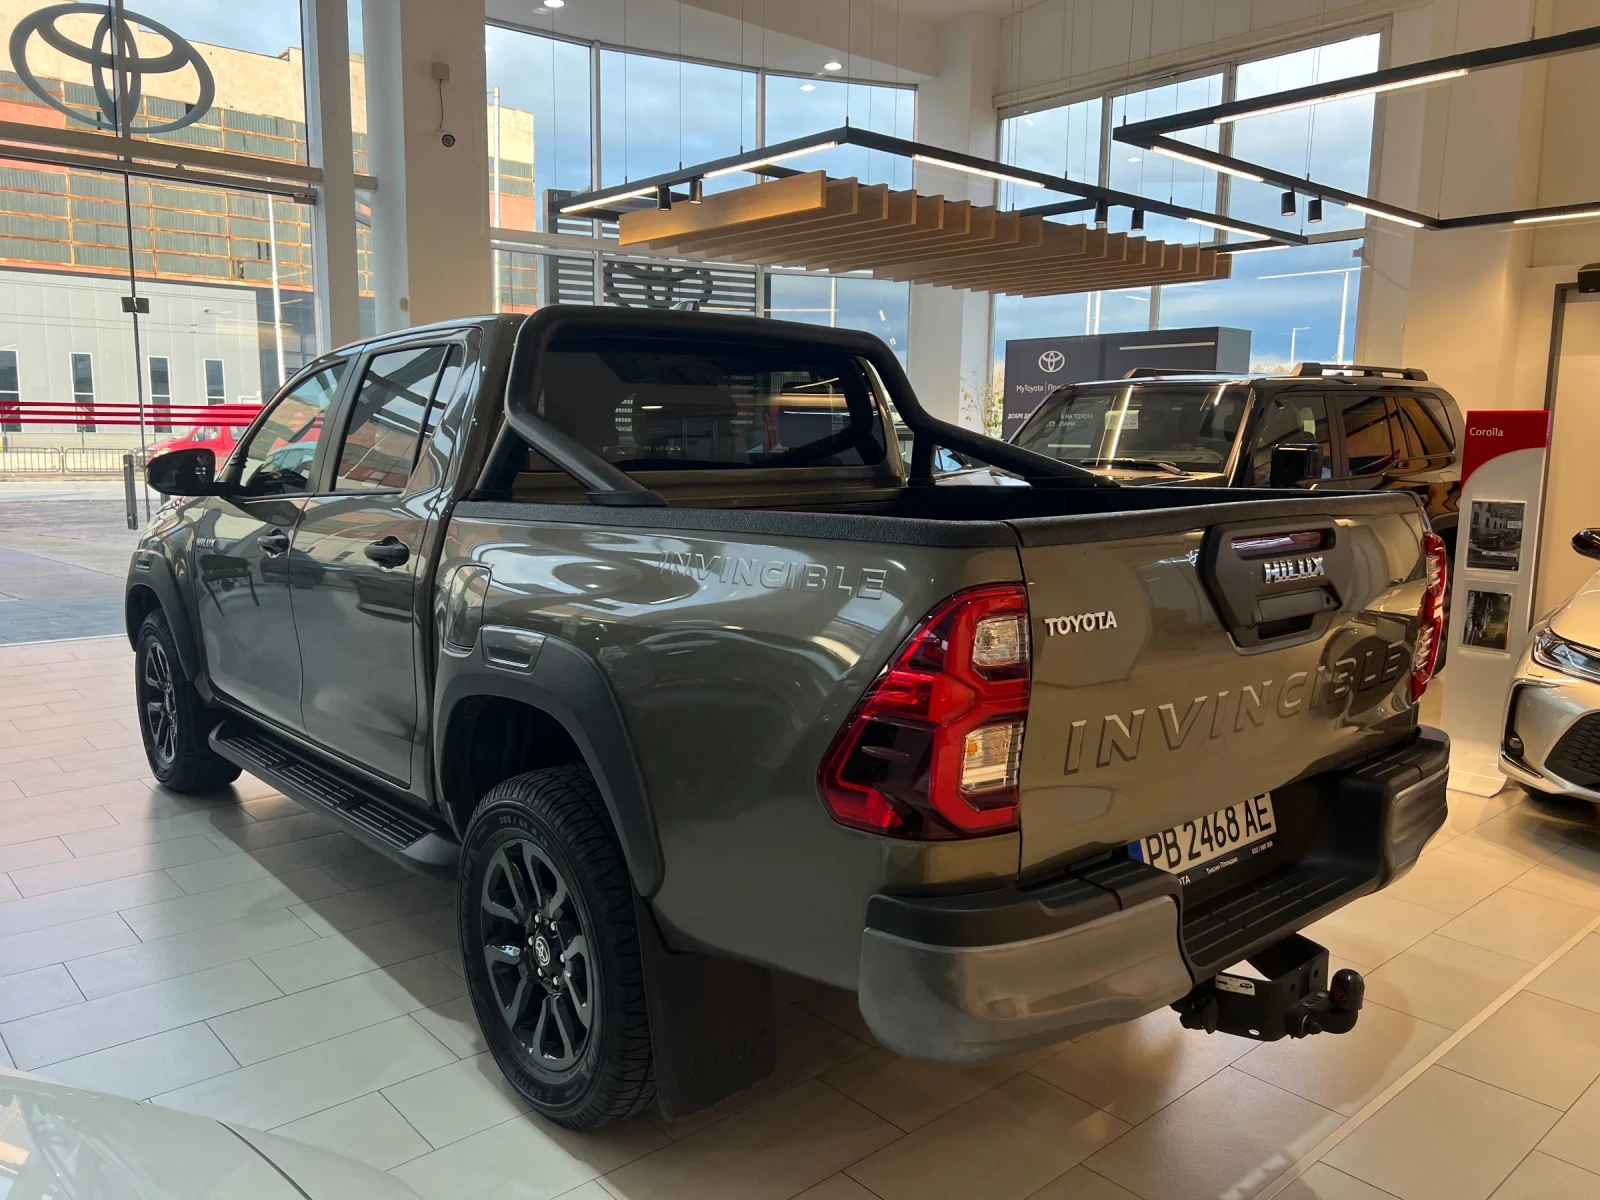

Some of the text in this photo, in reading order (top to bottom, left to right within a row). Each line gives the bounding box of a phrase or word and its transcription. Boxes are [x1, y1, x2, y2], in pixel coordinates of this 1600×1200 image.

[1016, 384, 1044, 394] MyToyota
[1469, 426, 1504, 437] Corolla
[657, 549, 888, 601] INVINCIBLE
[1263, 555, 1325, 584] HILUX
[1043, 610, 1118, 637] TOYOTA
[1063, 640, 1403, 775] INVINCIBLE
[1146, 794, 1272, 868] PB 2468 AE
